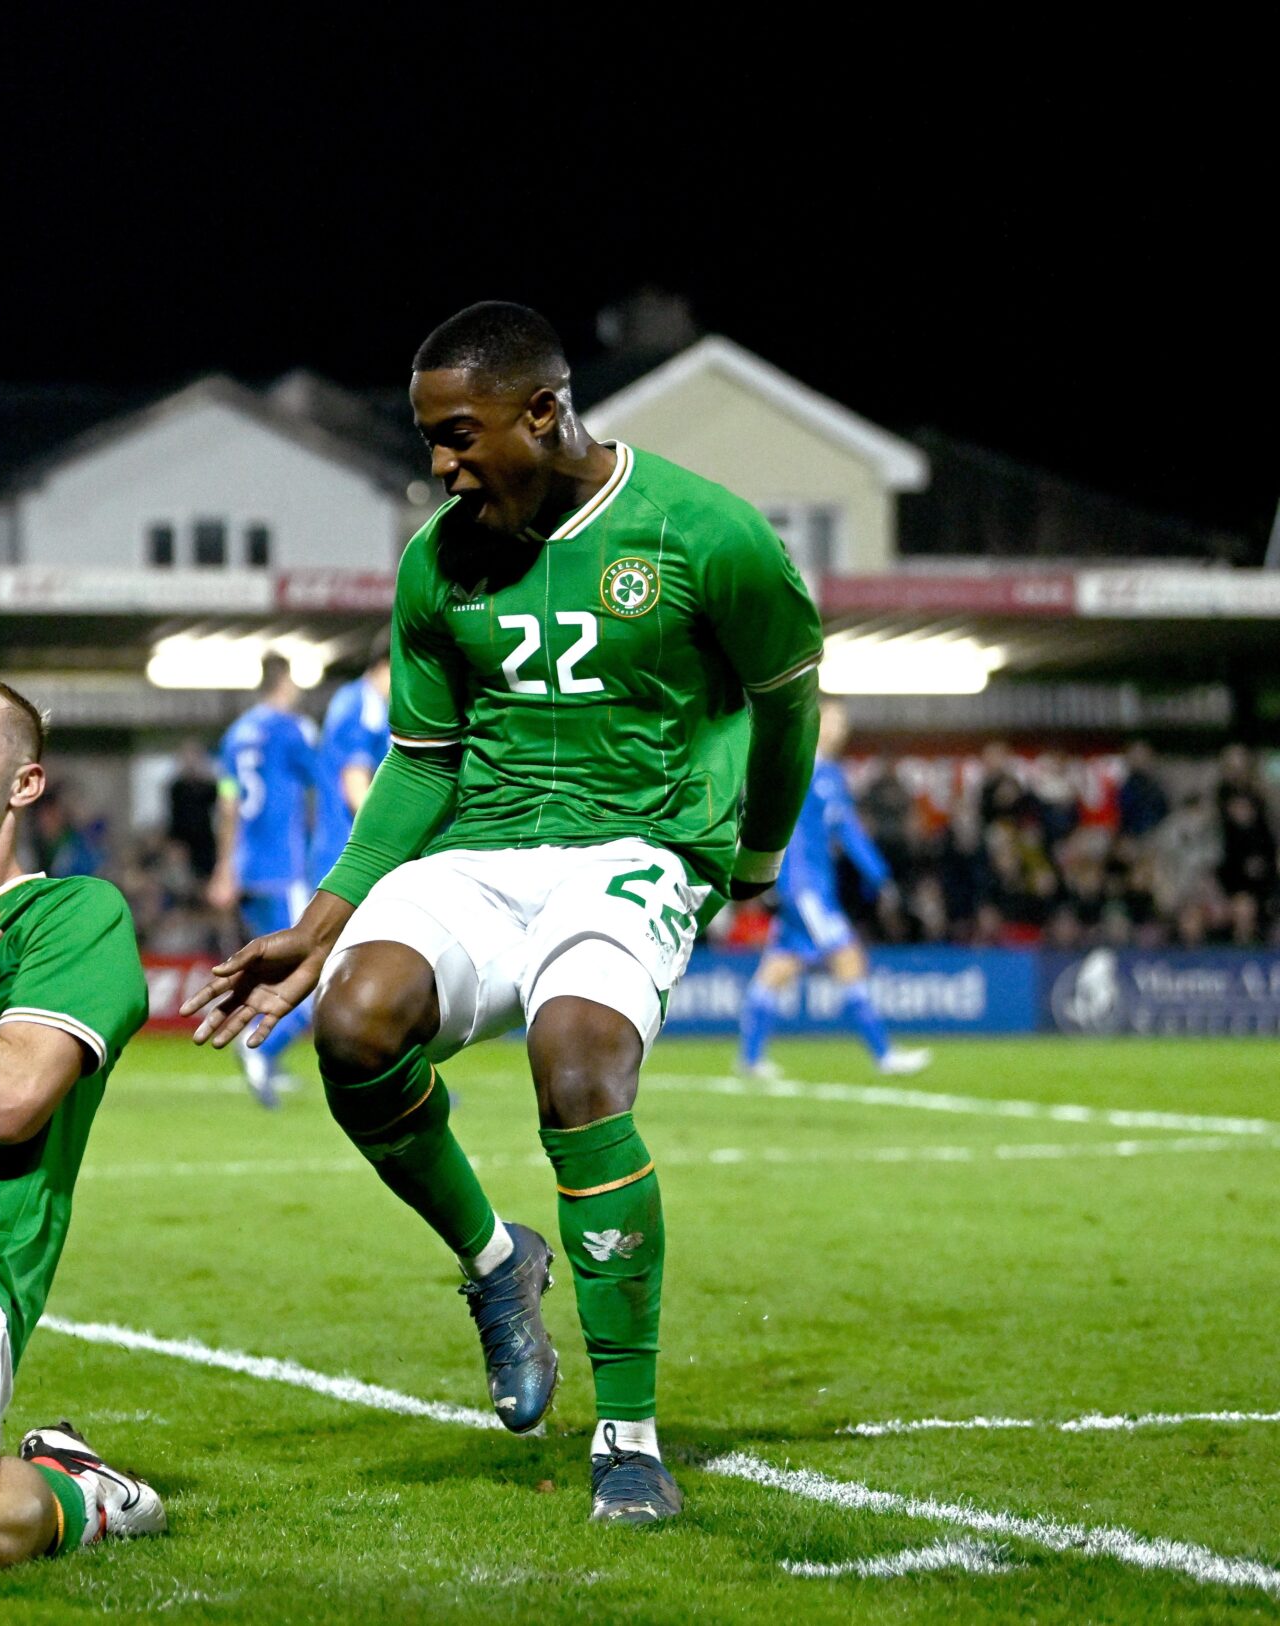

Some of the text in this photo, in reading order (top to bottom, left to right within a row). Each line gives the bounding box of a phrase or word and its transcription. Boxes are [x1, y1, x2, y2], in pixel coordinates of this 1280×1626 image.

[606, 562, 654, 581] IRELAND
[452, 603, 485, 612] CASTORE
[497, 611, 605, 695] 22
[236, 748, 265, 820] 5
